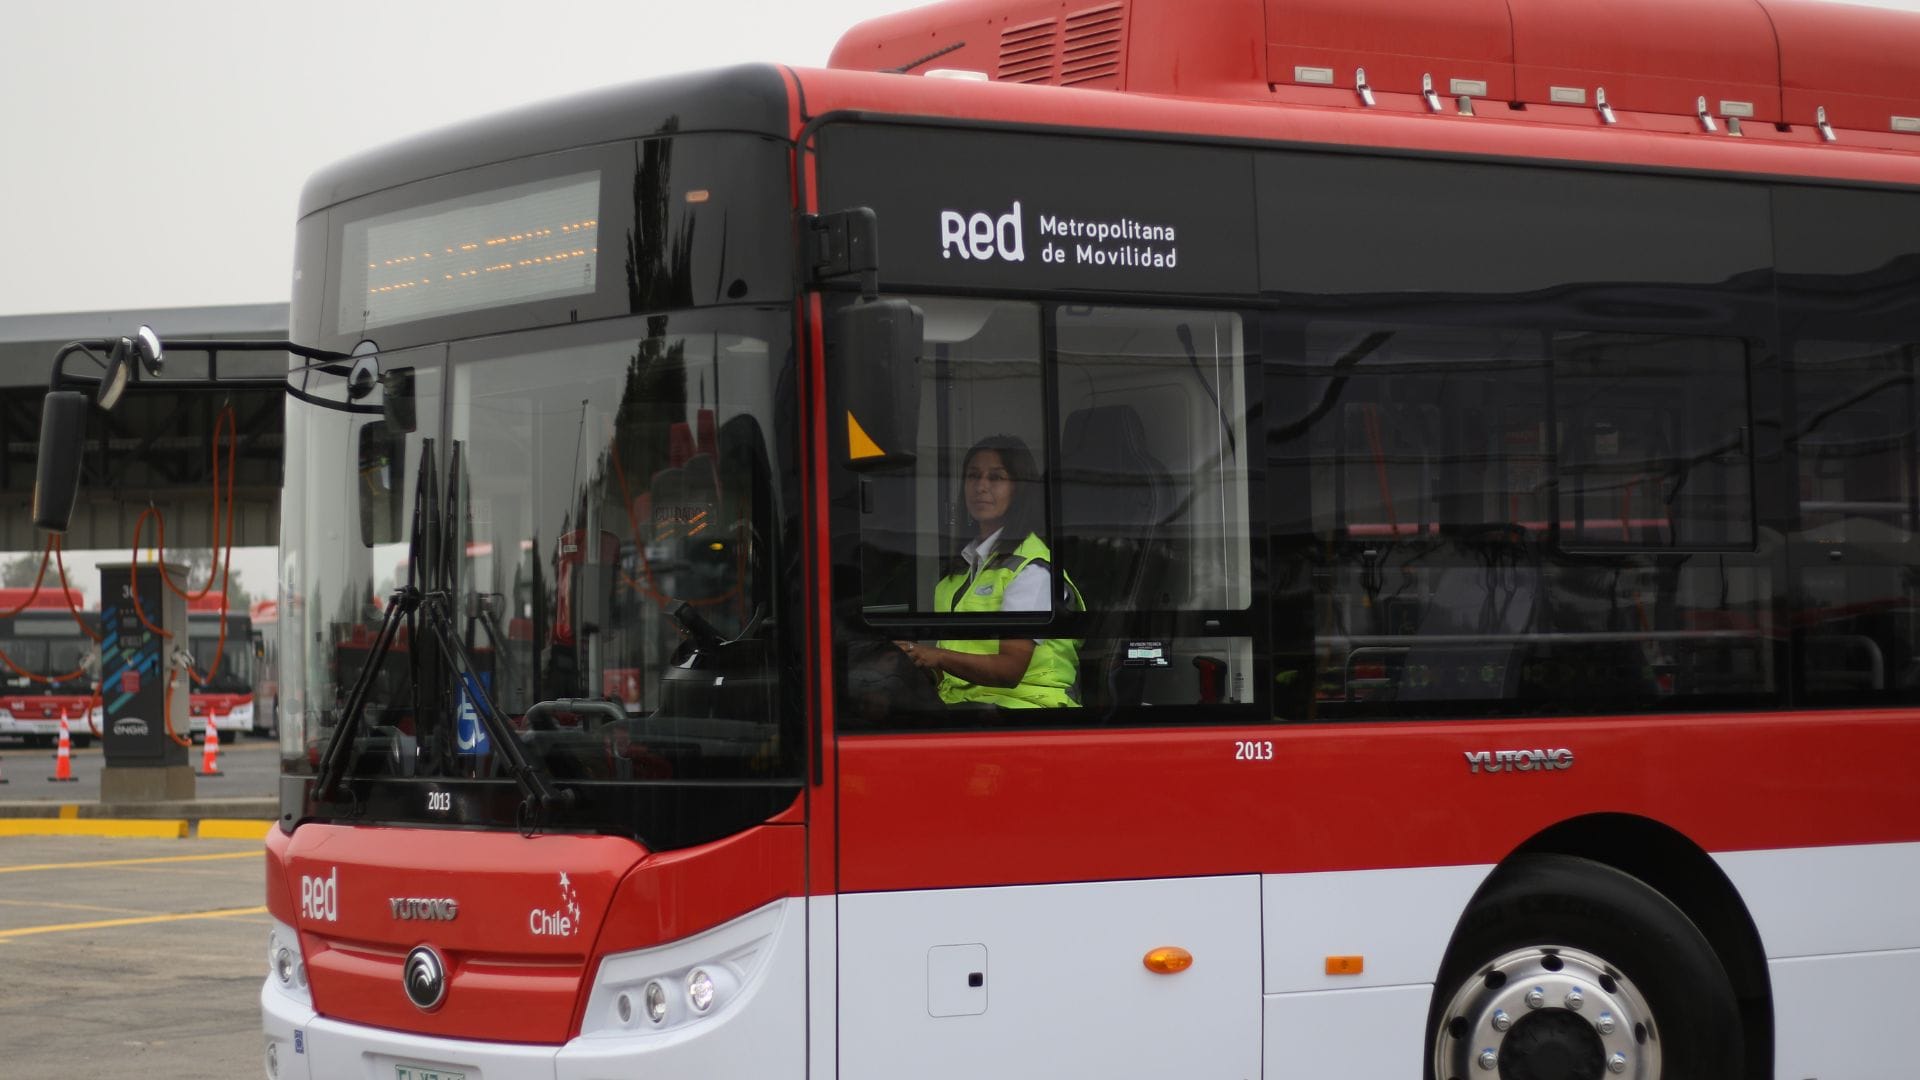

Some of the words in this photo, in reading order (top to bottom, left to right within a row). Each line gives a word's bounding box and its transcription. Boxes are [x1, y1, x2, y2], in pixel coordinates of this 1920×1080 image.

[940, 200, 1025, 262] Red
[1040, 215, 1175, 242] Metropolitana
[1042, 242, 1066, 263] de
[1076, 244, 1177, 268] Movilidad
[1235, 741, 1273, 760] 2013
[1464, 748, 1575, 774] YUTONG
[428, 792, 451, 811] 2013
[302, 866, 337, 921] Red
[389, 898, 458, 921] YUTONG
[530, 908, 571, 936] Chile
